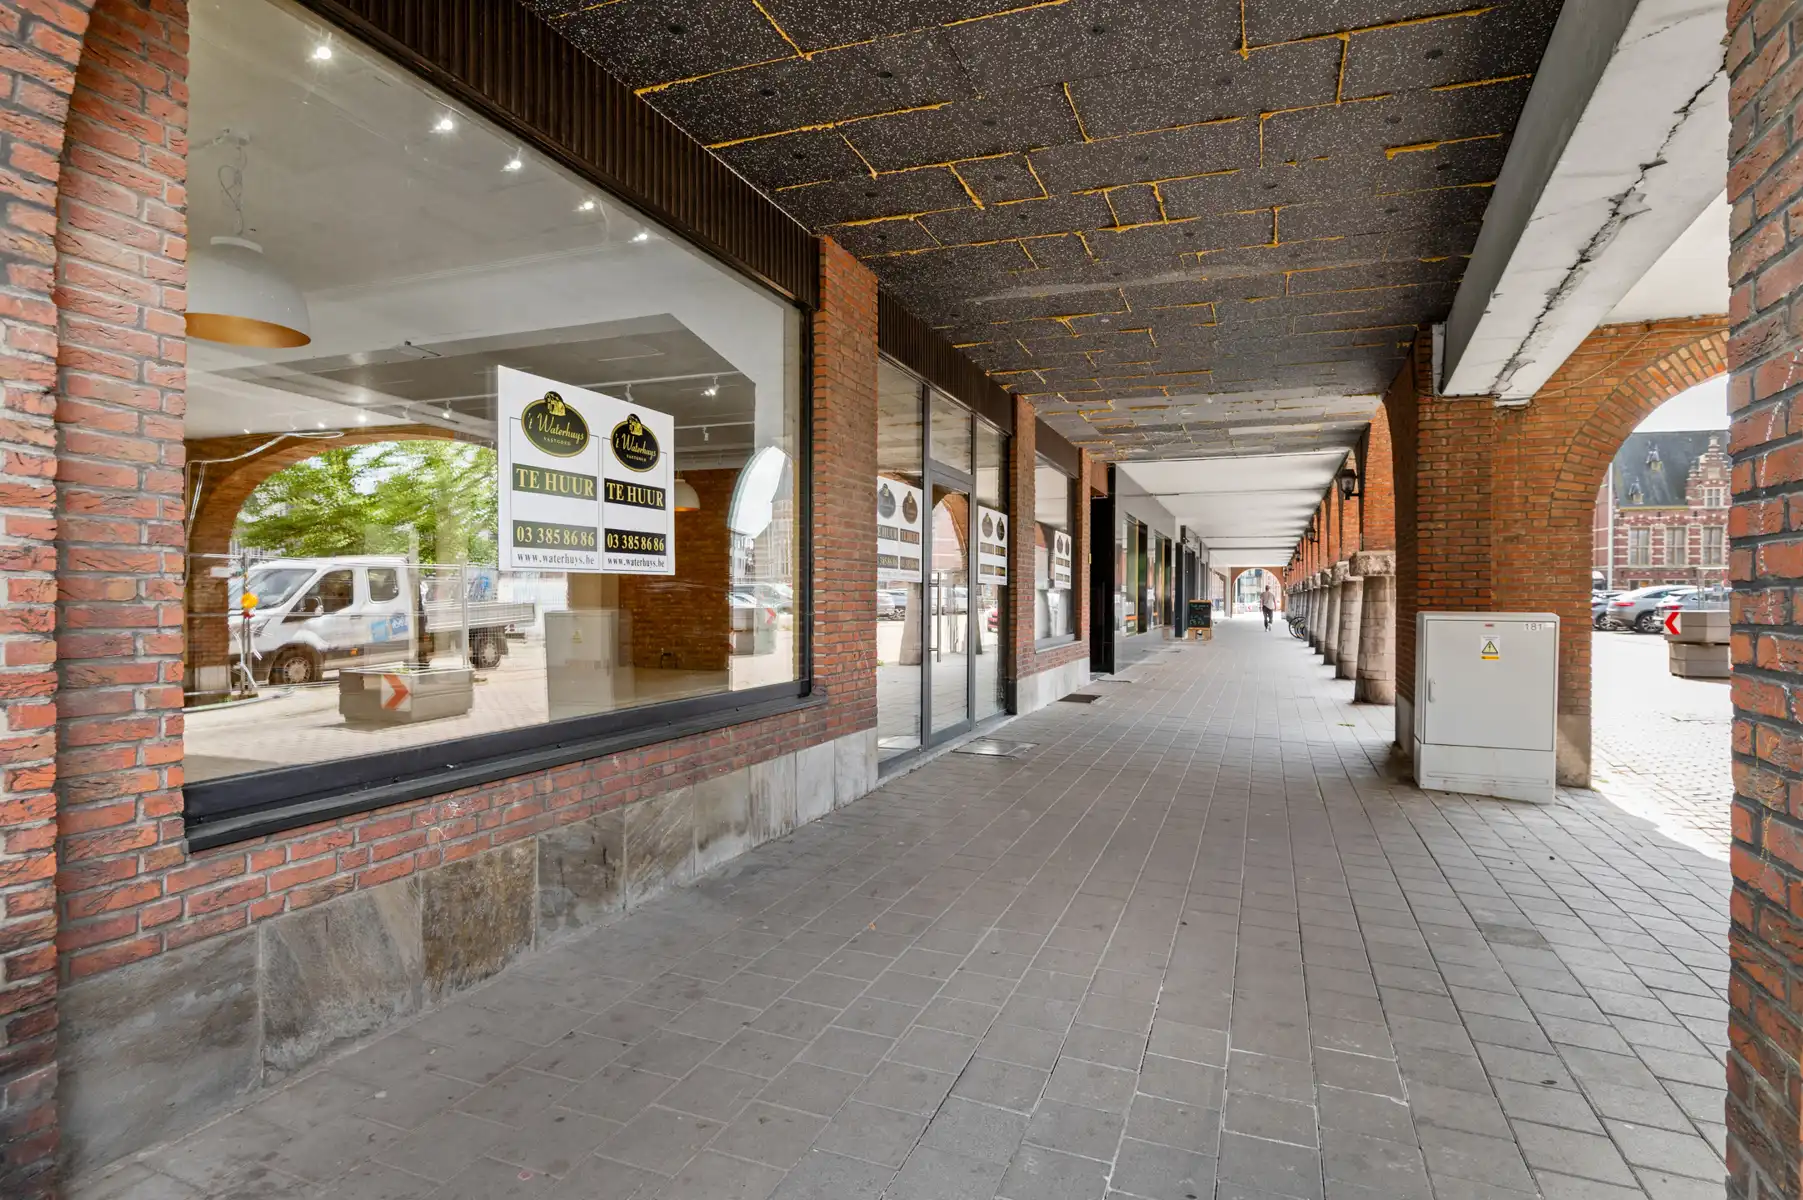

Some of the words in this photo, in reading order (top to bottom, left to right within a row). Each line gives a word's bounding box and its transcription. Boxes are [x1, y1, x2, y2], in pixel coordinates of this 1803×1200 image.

[536, 412, 584, 444] Waterhuys
[622, 434, 656, 460] Waterhuys
[516, 468, 540, 489] TE
[544, 472, 594, 496] HUUR
[606, 482, 624, 501] TE
[628, 486, 664, 507] HUUR
[517, 526, 532, 542] 03
[536, 528, 560, 544] 385
[607, 533, 619, 548] 03
[622, 535, 639, 550] 385
[518, 553, 594, 566] www.waterhuys.be
[608, 557, 664, 568] www.waterhuys.be
[1525, 622, 1542, 630] 181
